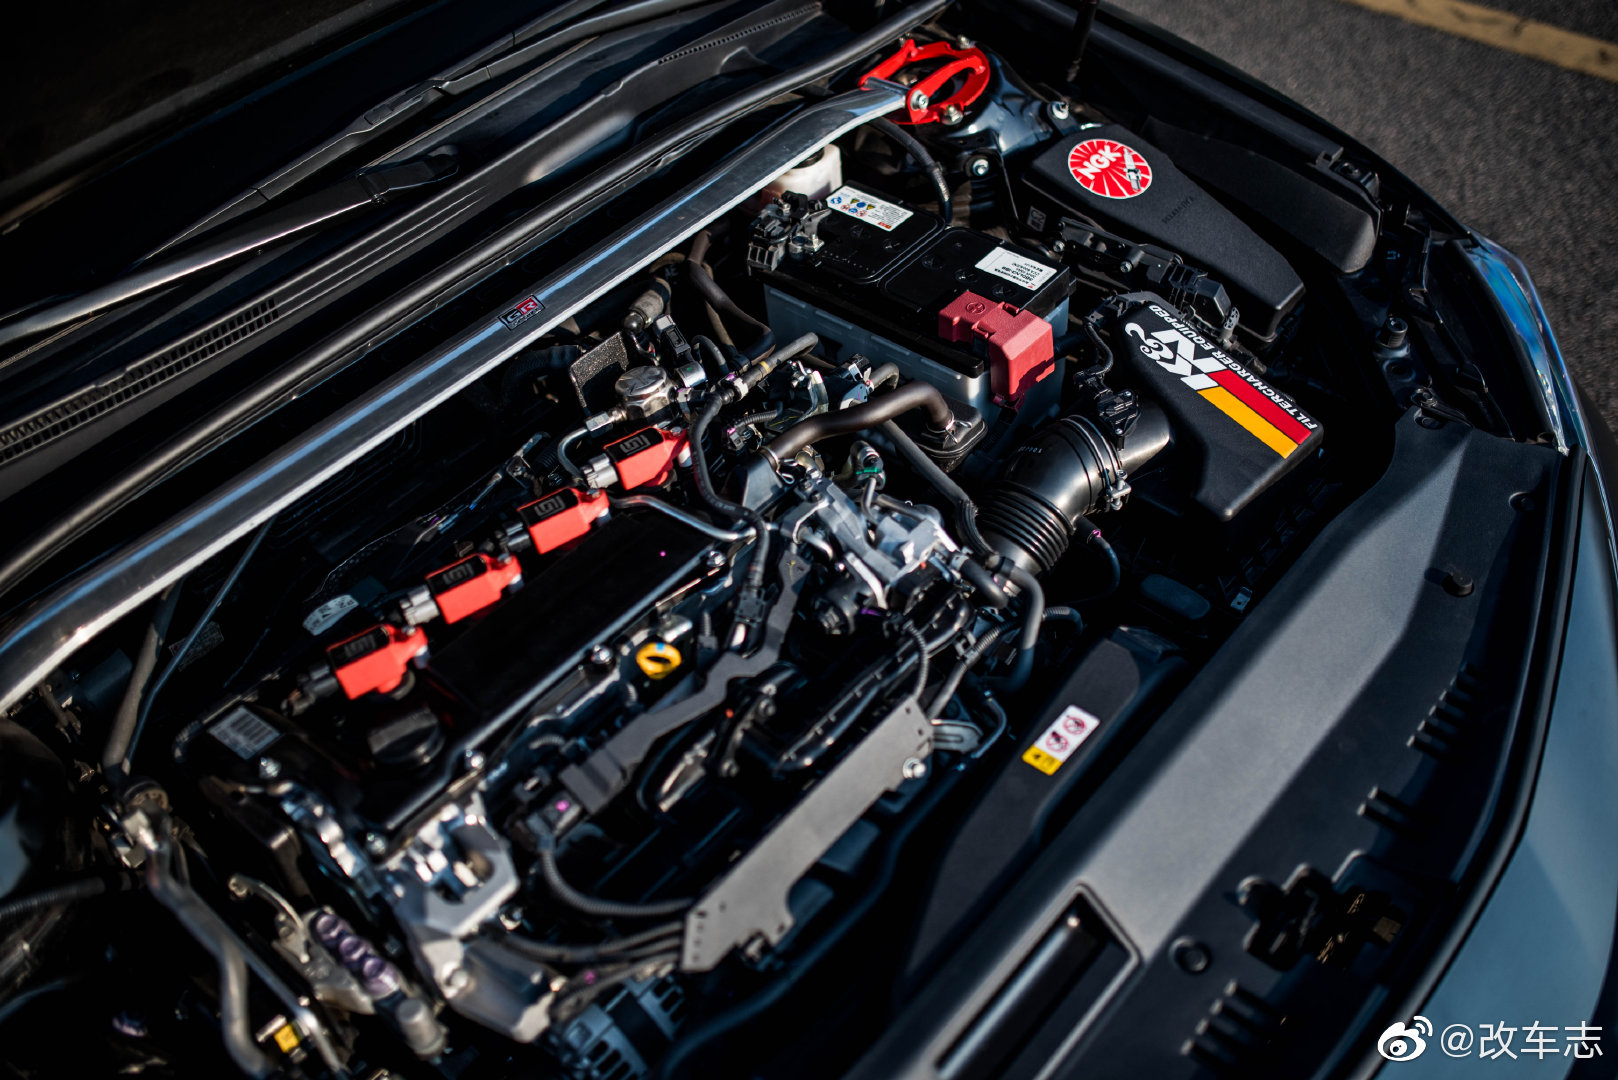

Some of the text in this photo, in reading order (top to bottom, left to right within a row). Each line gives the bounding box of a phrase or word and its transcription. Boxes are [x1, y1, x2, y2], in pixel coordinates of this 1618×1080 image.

[1077, 145, 1122, 180] NGK
[507, 301, 537, 322] GR
[1125, 322, 1227, 391] K&N
[1149, 304, 1318, 430] FILTERCHARGER EQUIPPED
